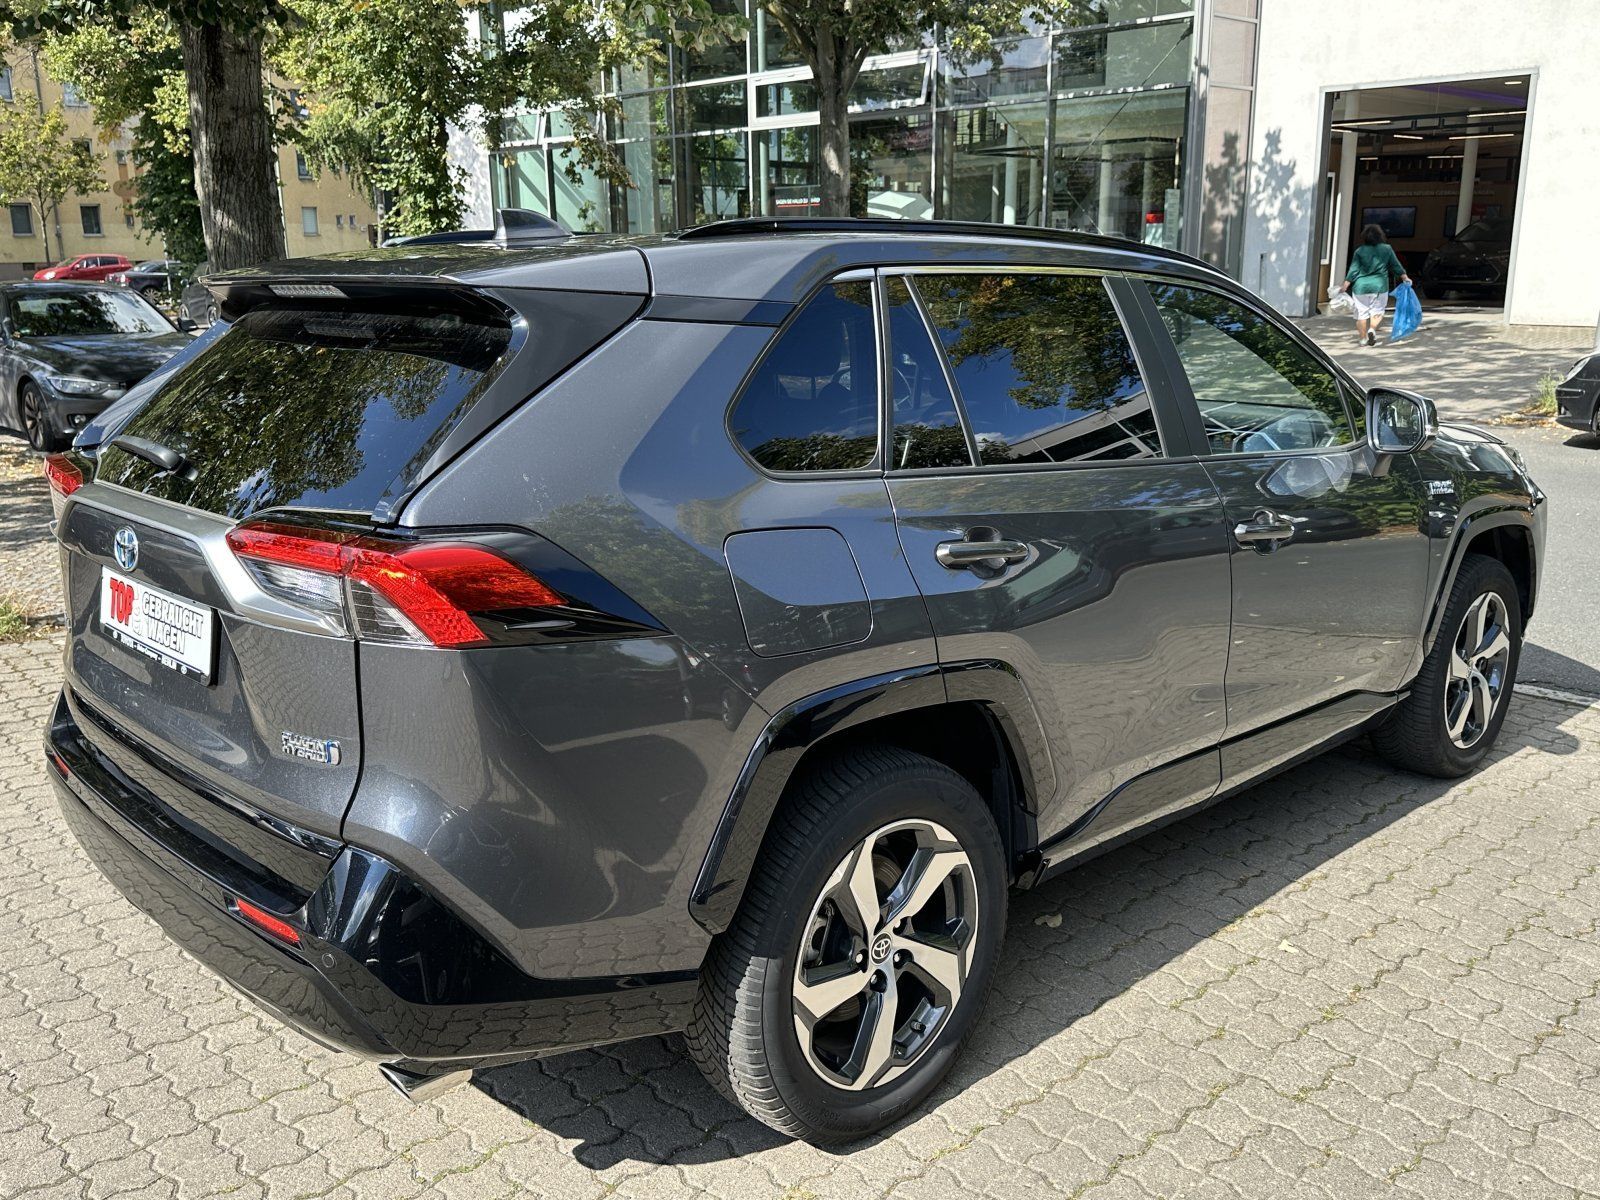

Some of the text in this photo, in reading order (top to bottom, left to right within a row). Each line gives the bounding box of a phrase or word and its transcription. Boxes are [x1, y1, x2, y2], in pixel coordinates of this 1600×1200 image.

[109, 577, 135, 626] TOP
[142, 591, 204, 639] GEBRAUCHT
[147, 617, 186, 655] WAGEN
